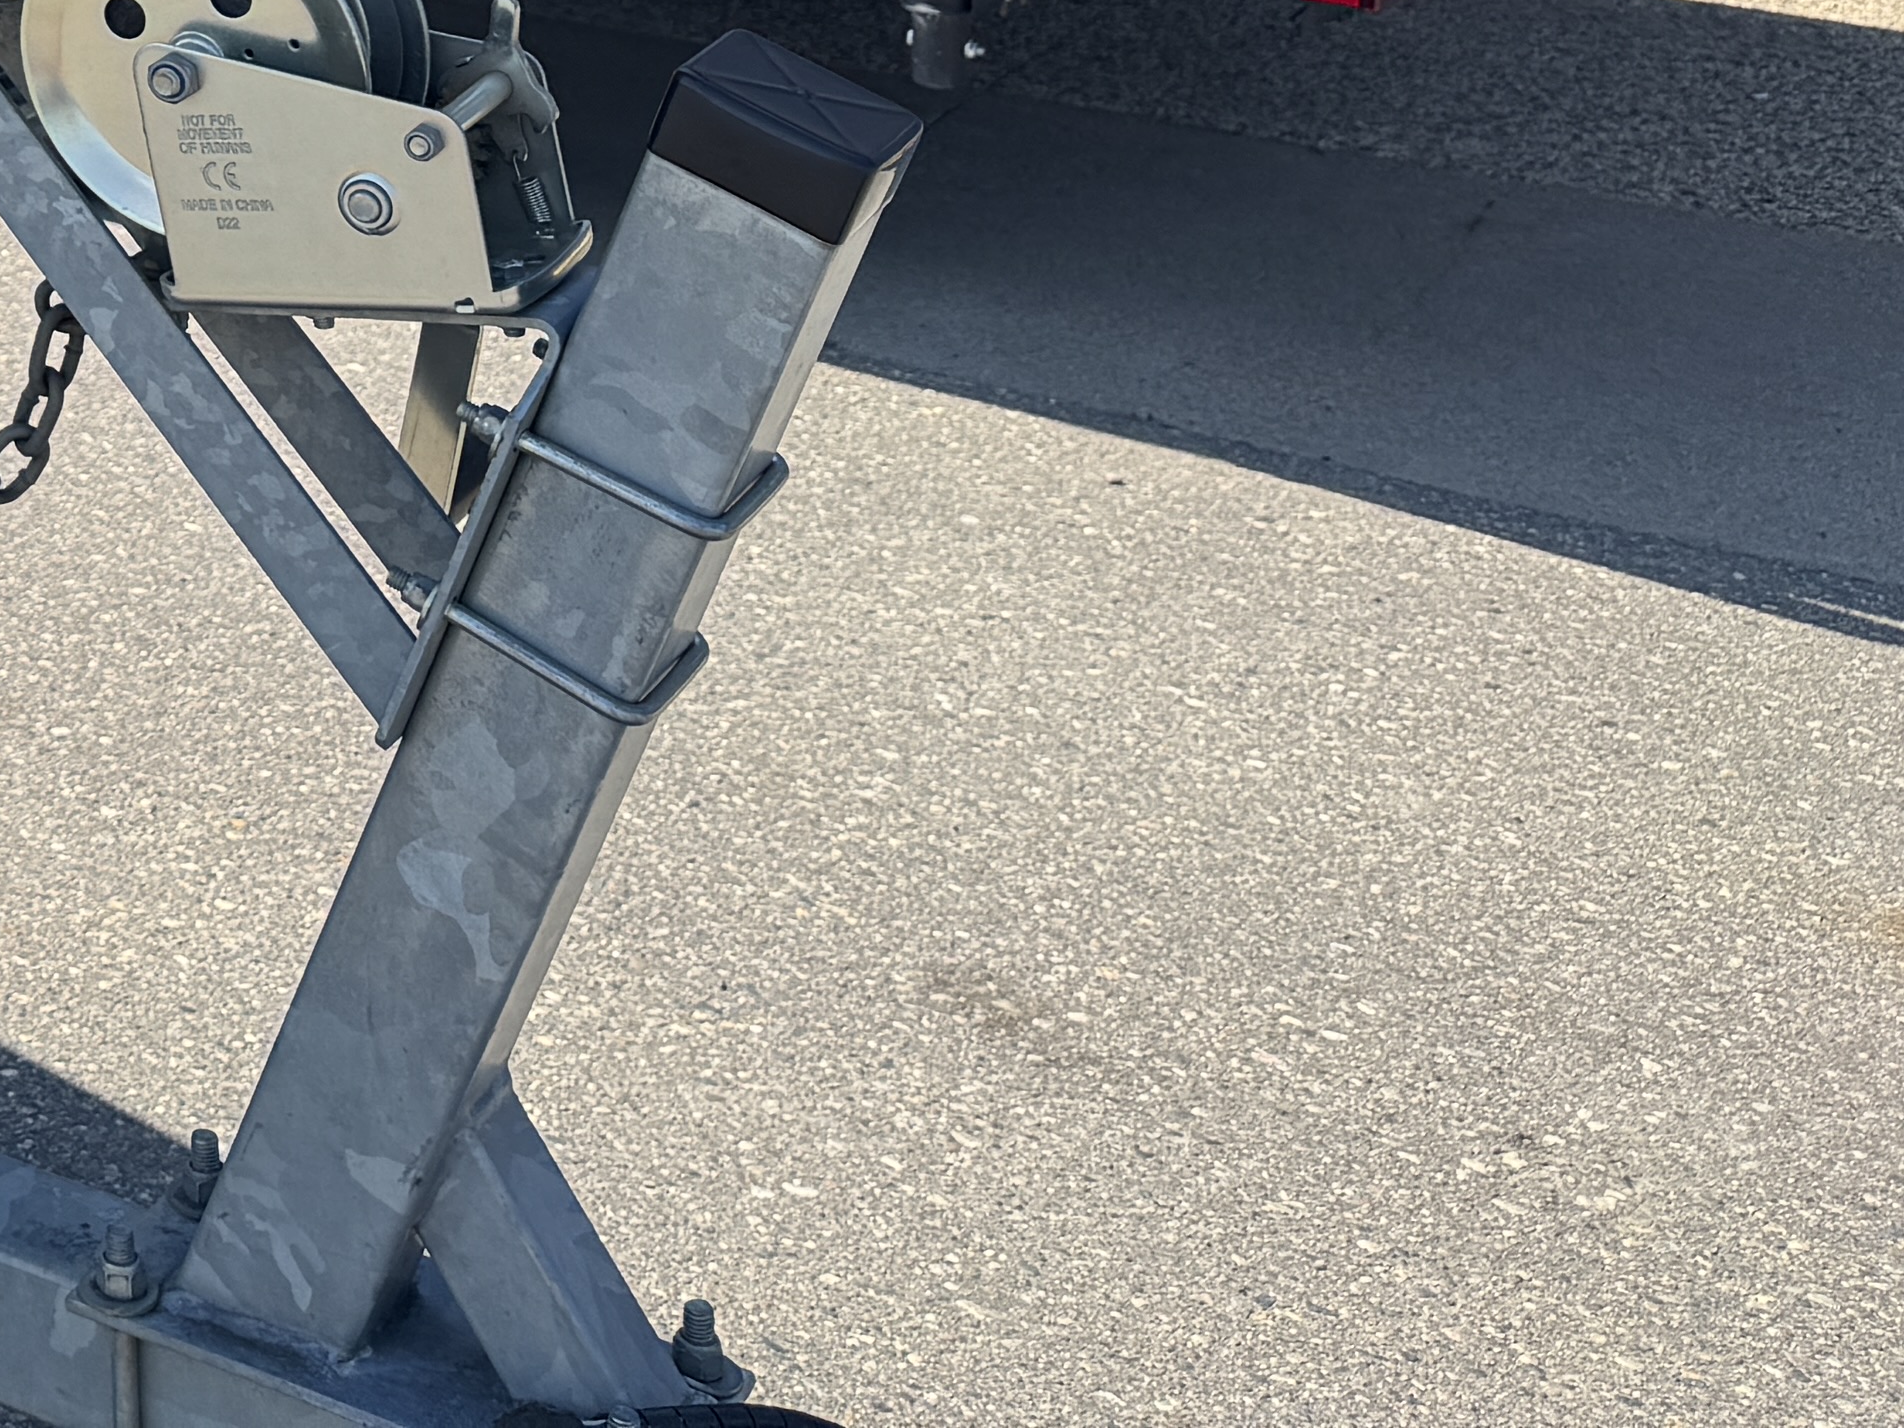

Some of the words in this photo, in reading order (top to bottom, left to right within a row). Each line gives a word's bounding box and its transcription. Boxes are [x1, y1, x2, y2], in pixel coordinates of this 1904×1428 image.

[181, 114, 206, 126] NOT
[209, 114, 236, 126] FOR
[177, 127, 244, 141] MOVEMENT
[179, 142, 197, 154] OF
[201, 142, 253, 154] HUMANS
[181, 199, 218, 211] MADE
[220, 199, 234, 211] IN
[235, 199, 275, 212] CHINA
[216, 217, 241, 230] D22
